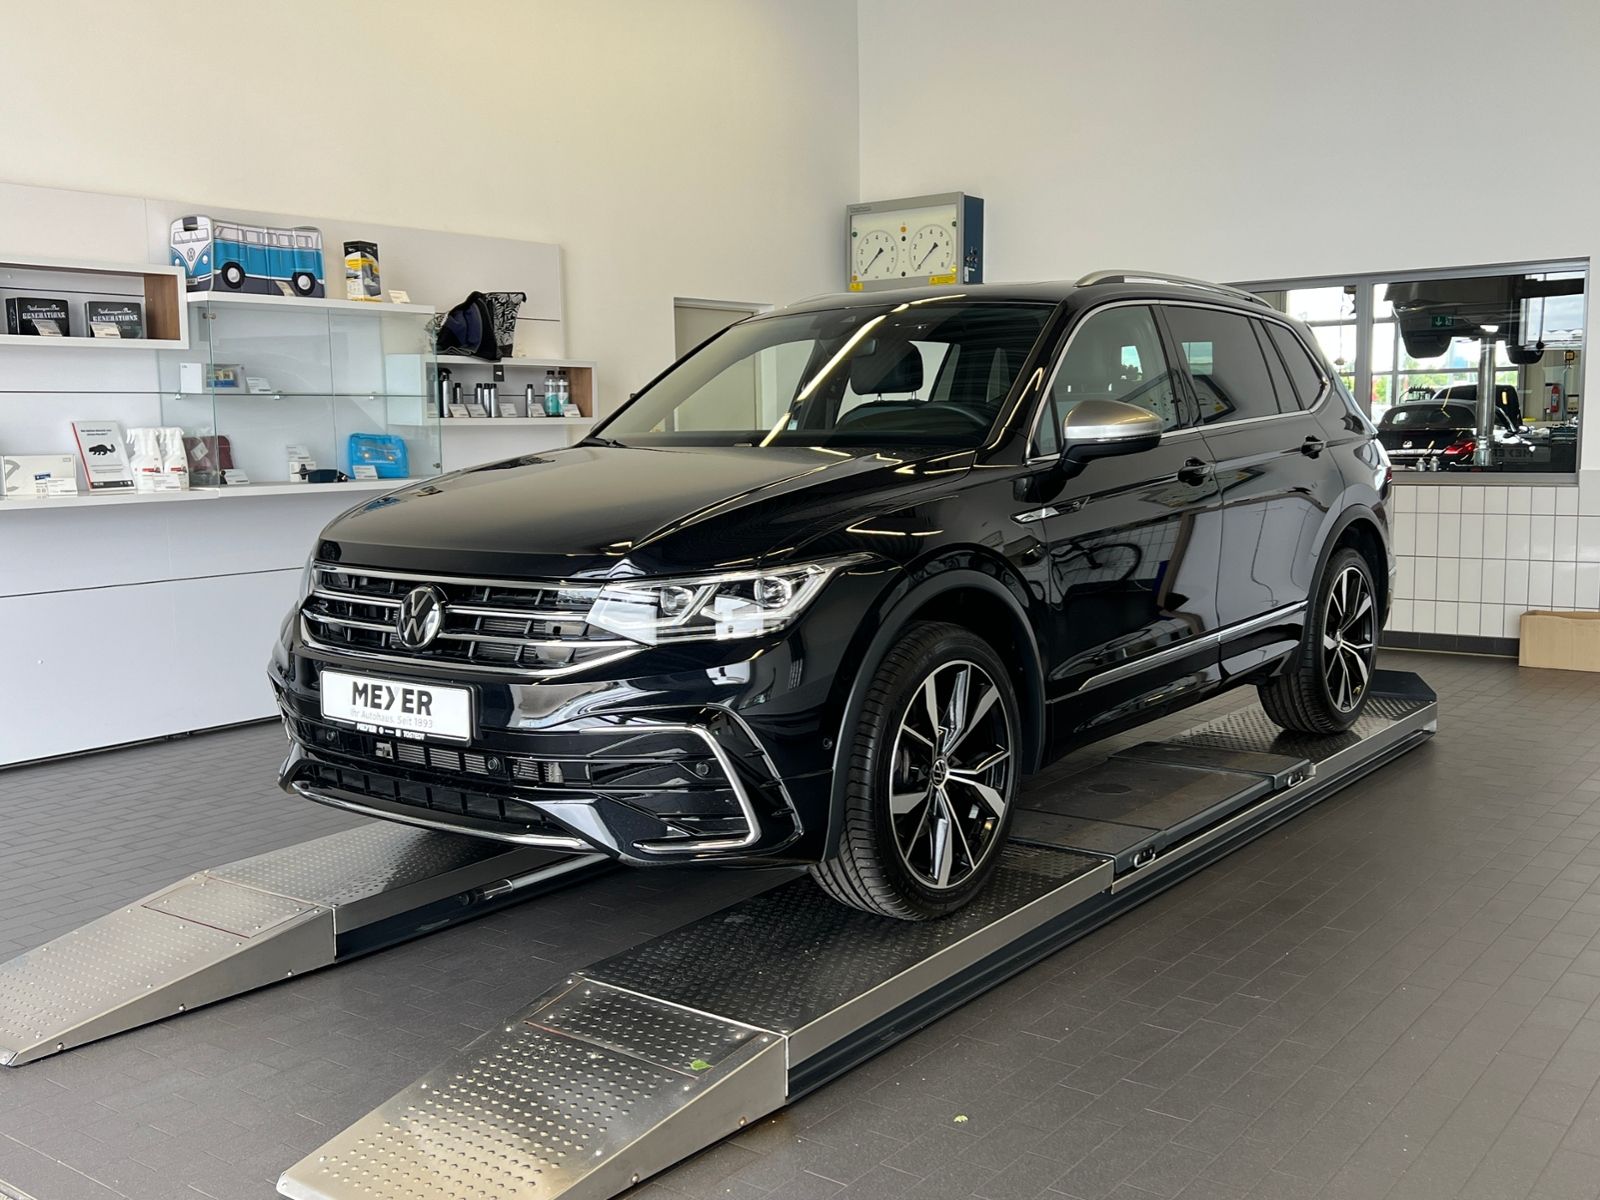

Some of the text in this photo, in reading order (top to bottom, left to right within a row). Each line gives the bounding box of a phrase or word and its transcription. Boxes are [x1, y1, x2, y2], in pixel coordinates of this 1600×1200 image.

[22, 311, 66, 319] GENERATIONS
[352, 681, 432, 716] MEYER
[397, 715, 412, 726] Seit
